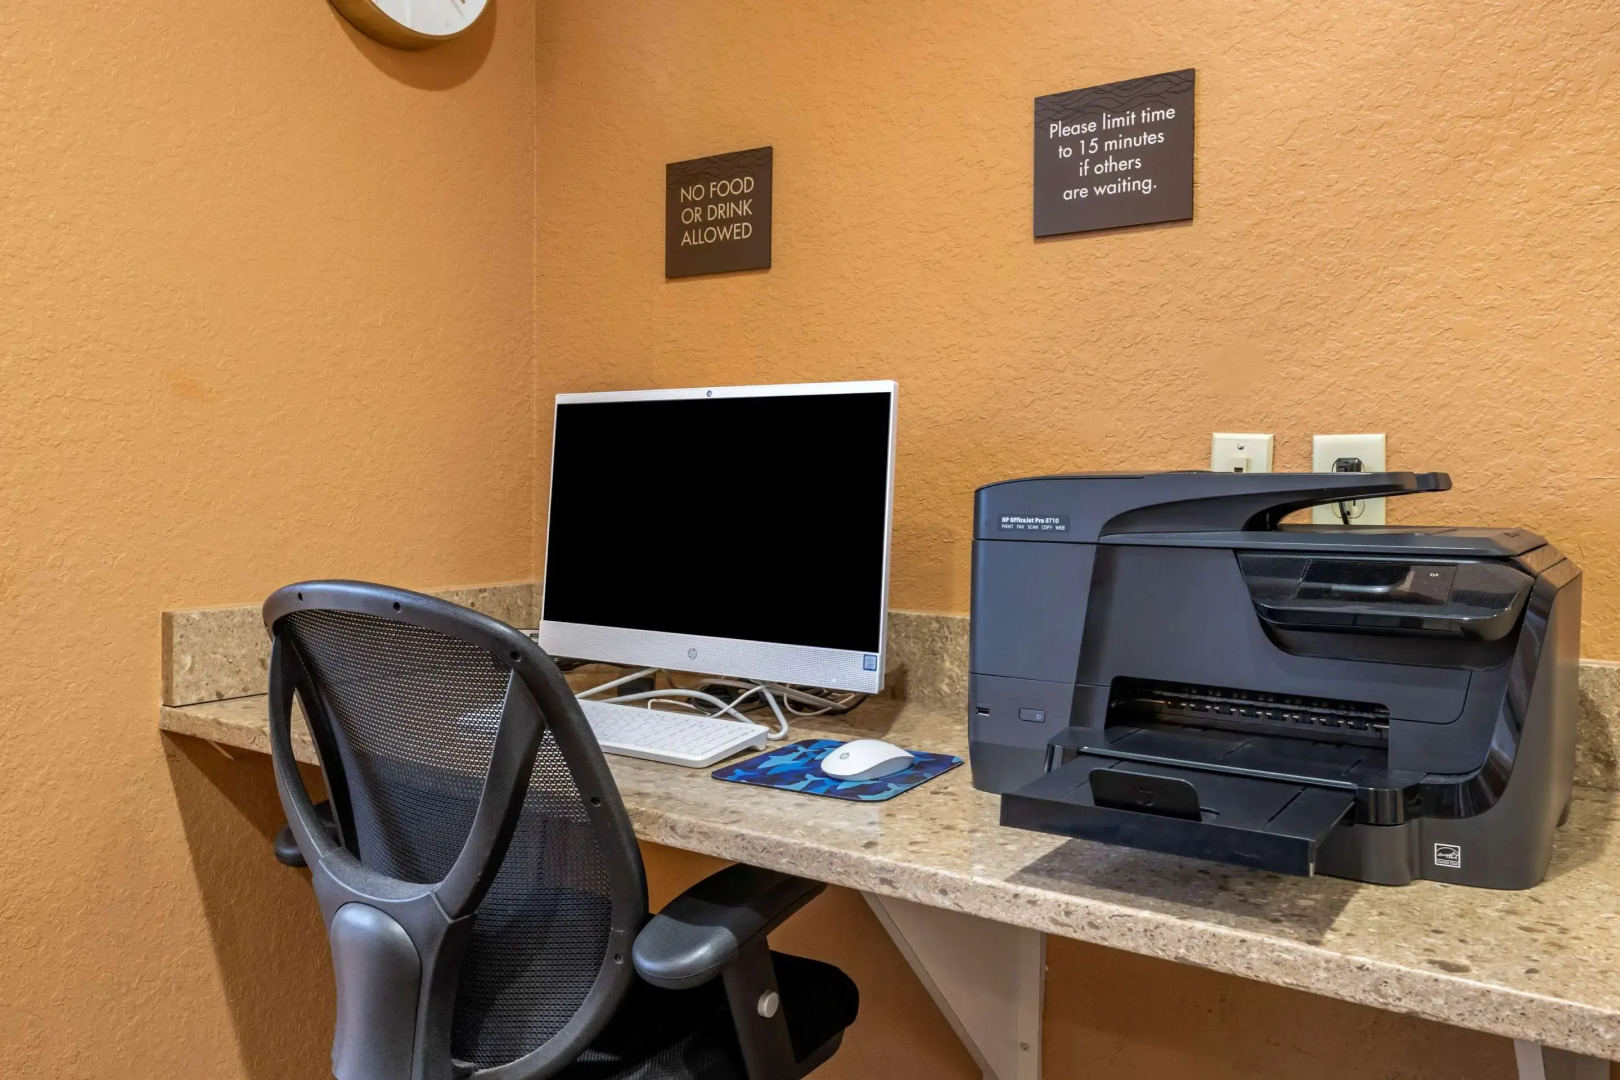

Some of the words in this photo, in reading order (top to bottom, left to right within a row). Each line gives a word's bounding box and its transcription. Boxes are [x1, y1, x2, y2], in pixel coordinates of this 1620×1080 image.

[1050, 120, 1097, 138] Please
[1102, 110, 1136, 130] limit
[1141, 108, 1176, 124] time
[1058, 146, 1072, 158] to
[1079, 138, 1098, 154] 15
[1104, 132, 1164, 151] minutes
[1079, 158, 1090, 176] if
[1094, 155, 1142, 174] others
[680, 184, 705, 202] NO
[710, 176, 754, 198] FOOD
[1063, 187, 1088, 200] are
[1094, 176, 1156, 194] waiting.
[681, 206, 702, 224] OR
[708, 199, 752, 220] DRINK
[681, 222, 752, 246] ALLOWED
